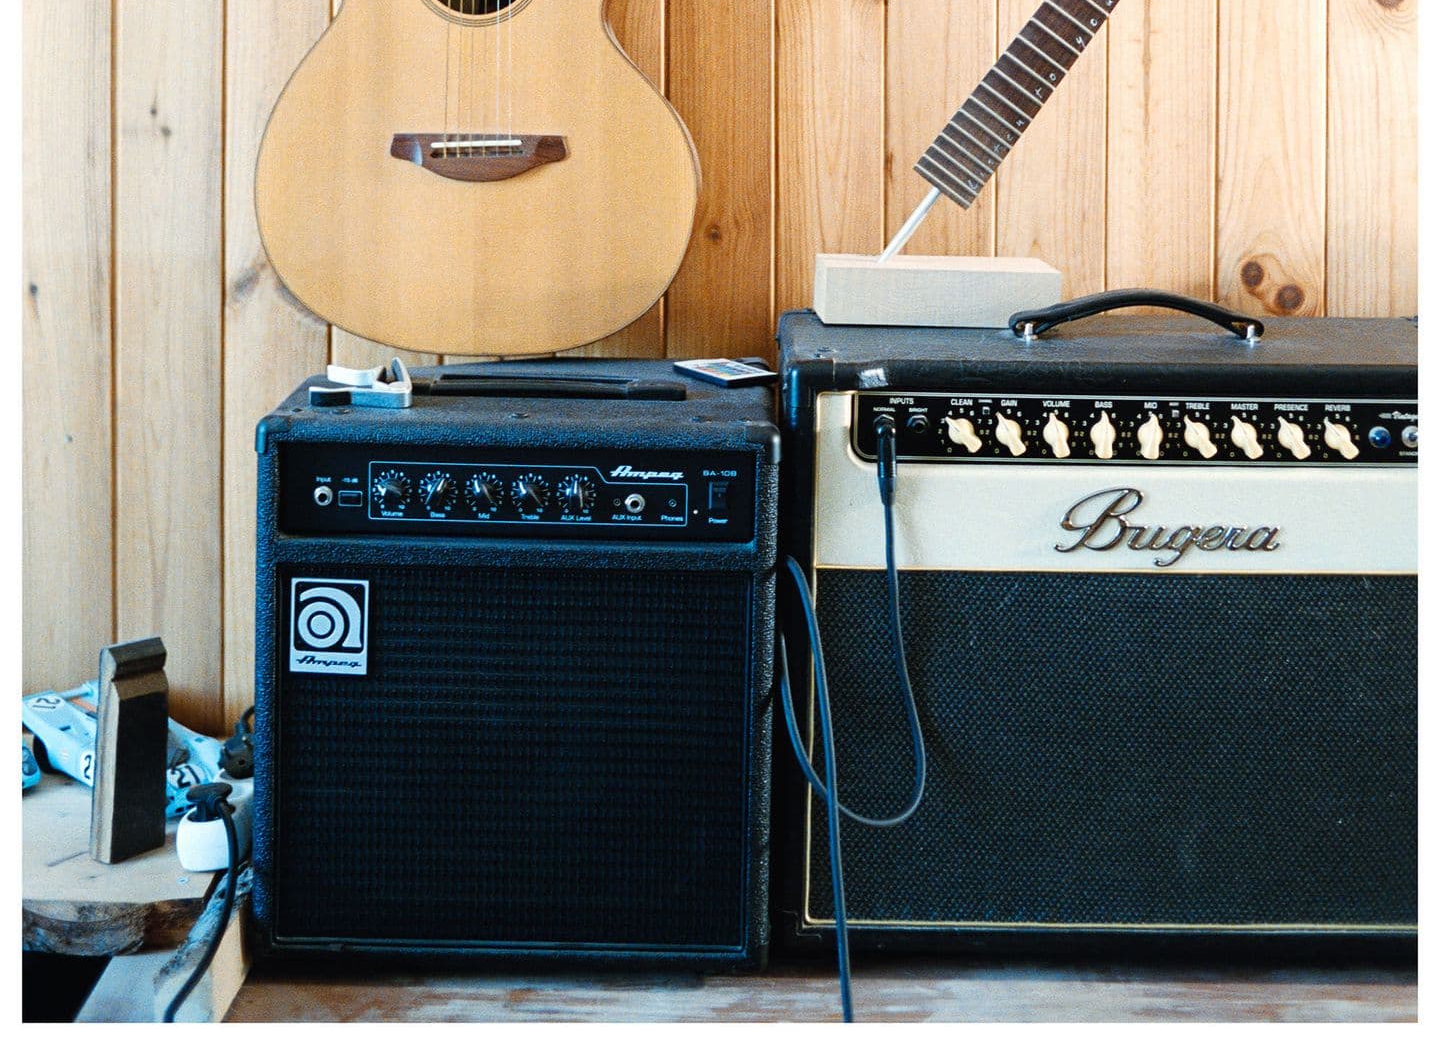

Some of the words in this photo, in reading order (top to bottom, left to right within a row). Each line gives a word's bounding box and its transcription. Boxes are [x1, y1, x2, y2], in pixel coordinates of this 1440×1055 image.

[1042, 400, 1071, 408] VOLUME
[1094, 401, 1113, 409] BASS
[1185, 402, 1210, 410] TREBLE
[1231, 403, 1259, 411] MASTER
[610, 465, 684, 480] Ampeg
[478, 512, 490, 520] Mid
[660, 514, 684, 522] Phones
[1054, 487, 1281, 567] Bugera
[296, 655, 362, 668] Ampeg
